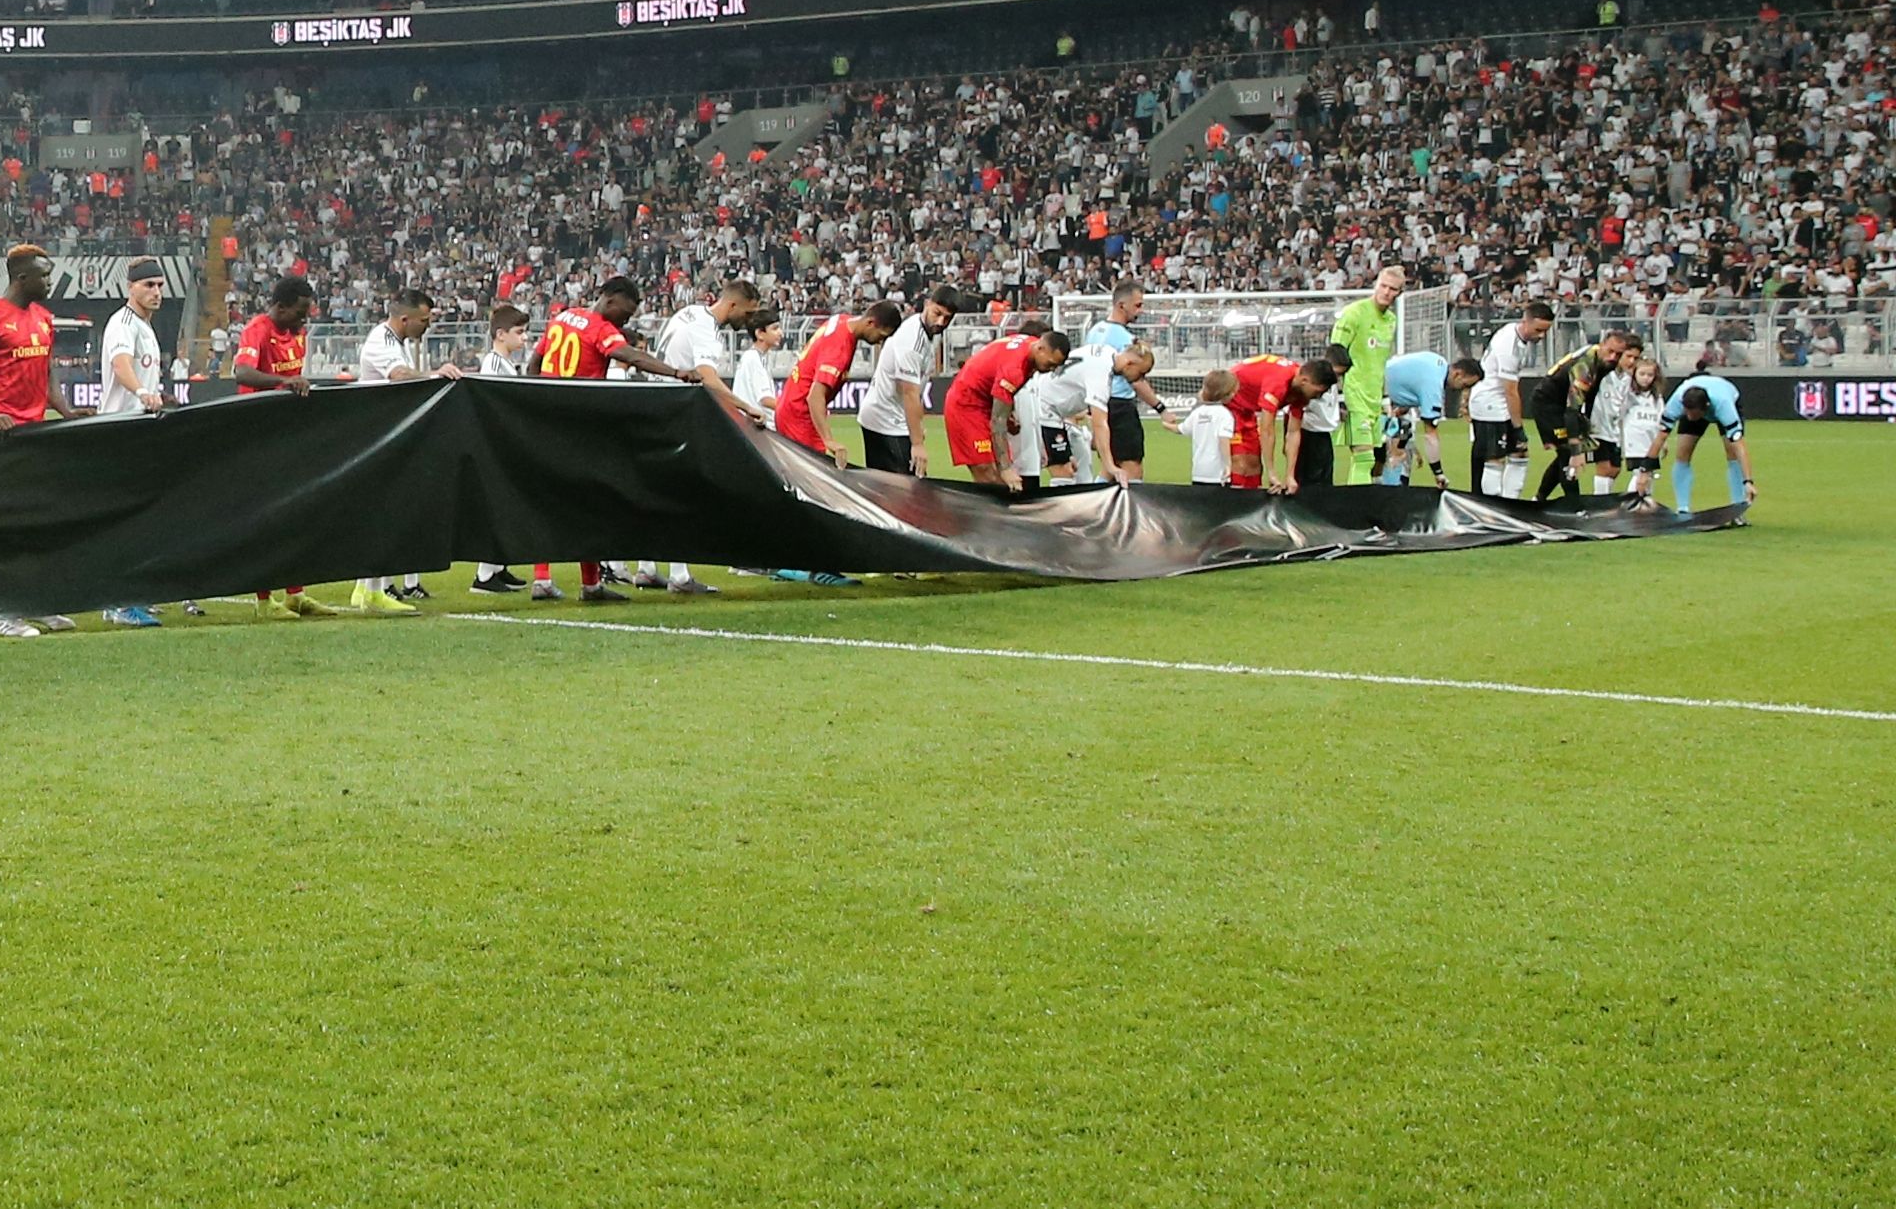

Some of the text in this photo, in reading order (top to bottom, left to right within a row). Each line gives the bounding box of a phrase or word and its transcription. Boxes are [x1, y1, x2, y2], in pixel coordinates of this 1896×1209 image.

[19, 27, 45, 47] JK
[294, 17, 412, 47] BEŞİKTAŞ JK
[1238, 90, 1261, 104] 120
[540, 324, 580, 378] 20
